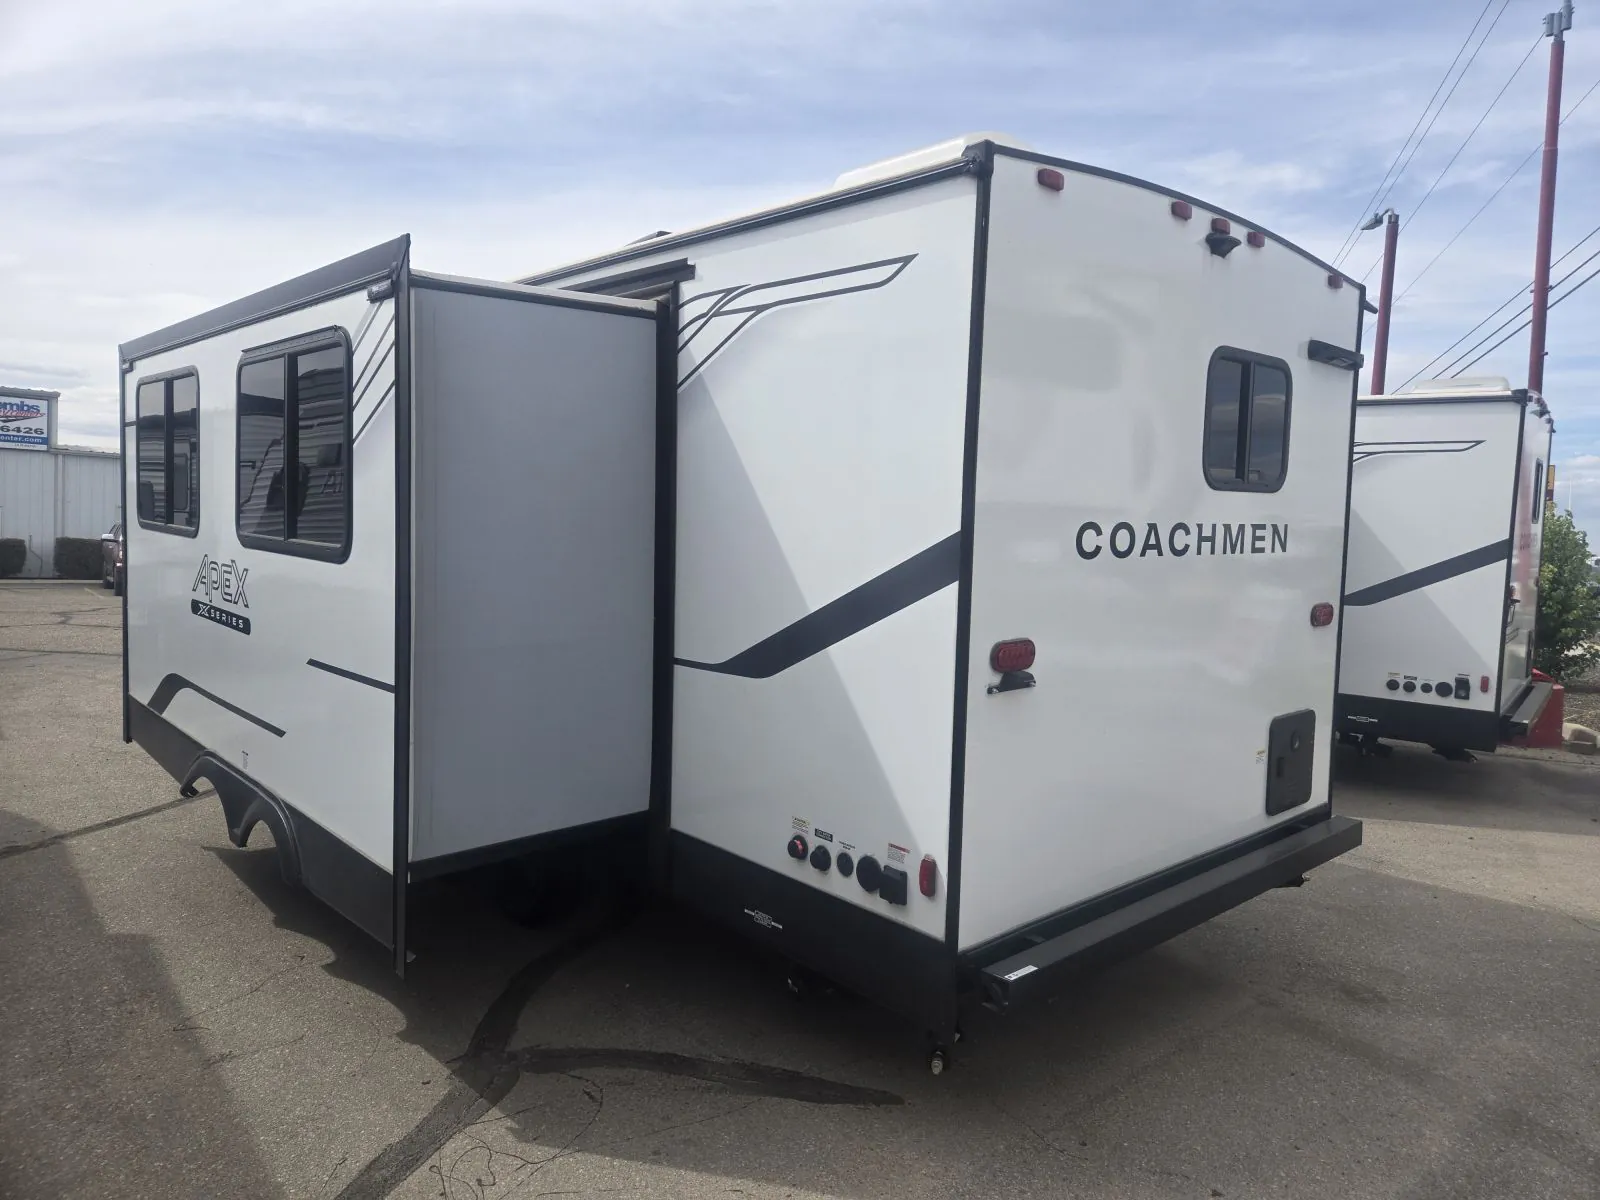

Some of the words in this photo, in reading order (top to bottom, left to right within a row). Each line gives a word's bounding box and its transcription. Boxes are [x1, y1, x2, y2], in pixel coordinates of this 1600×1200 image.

[0, 400, 41, 412] mbs
[1075, 521, 1289, 560] COACHMEN
[192, 553, 249, 608] APEX
[210, 609, 244, 628] SERIES
